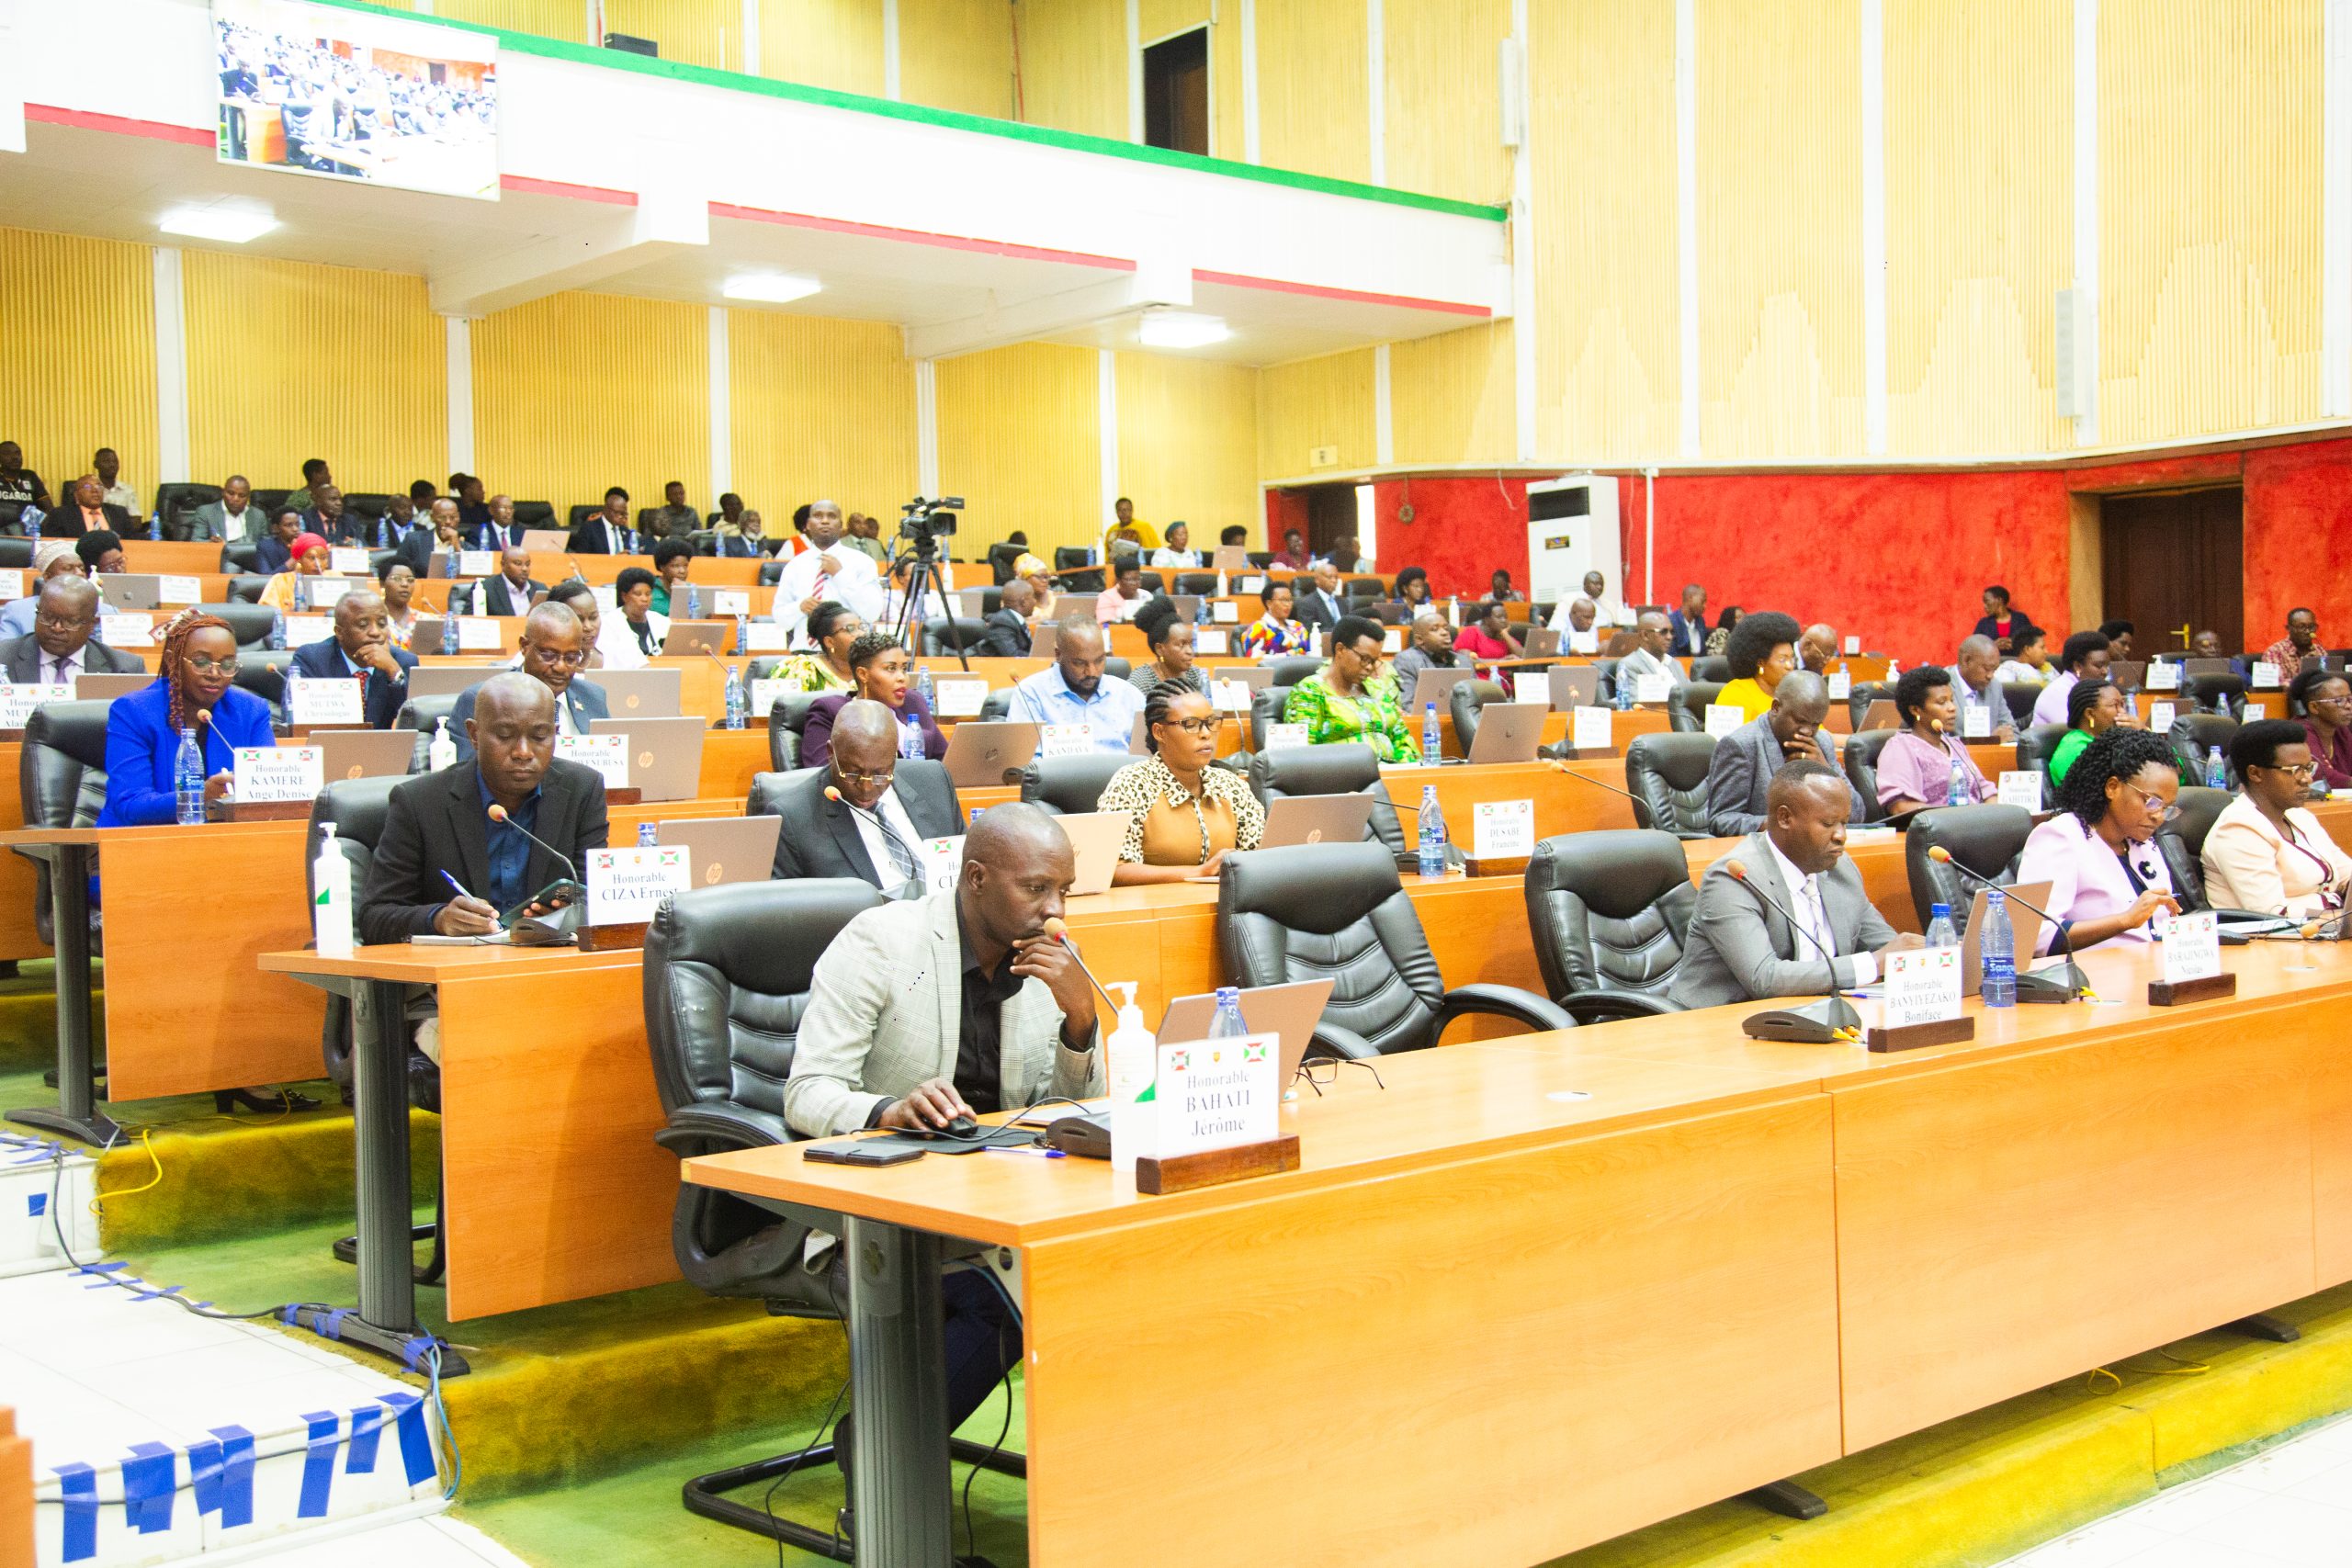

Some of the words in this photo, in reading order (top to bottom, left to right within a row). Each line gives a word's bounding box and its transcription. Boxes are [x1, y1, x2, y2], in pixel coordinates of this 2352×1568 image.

[0, 491, 33, 501] GANDA
[571, 750, 611, 758] Honorable
[255, 764, 301, 773] Honorable
[251, 775, 306, 785] KAMERE
[248, 789, 273, 800] Ange
[277, 788, 311, 799] Denise
[613, 872, 667, 885] Honorable
[602, 887, 637, 901] CIZA
[1904, 978, 1942, 992] Honorable
[1890, 991, 1956, 1009] BANYIYEZAKO
[1905, 1009, 1942, 1023] Boniface
[1187, 1069, 1250, 1089] Honorable
[1186, 1089, 1250, 1113] BAHATI
[1191, 1115, 1246, 1138] Jérôme
